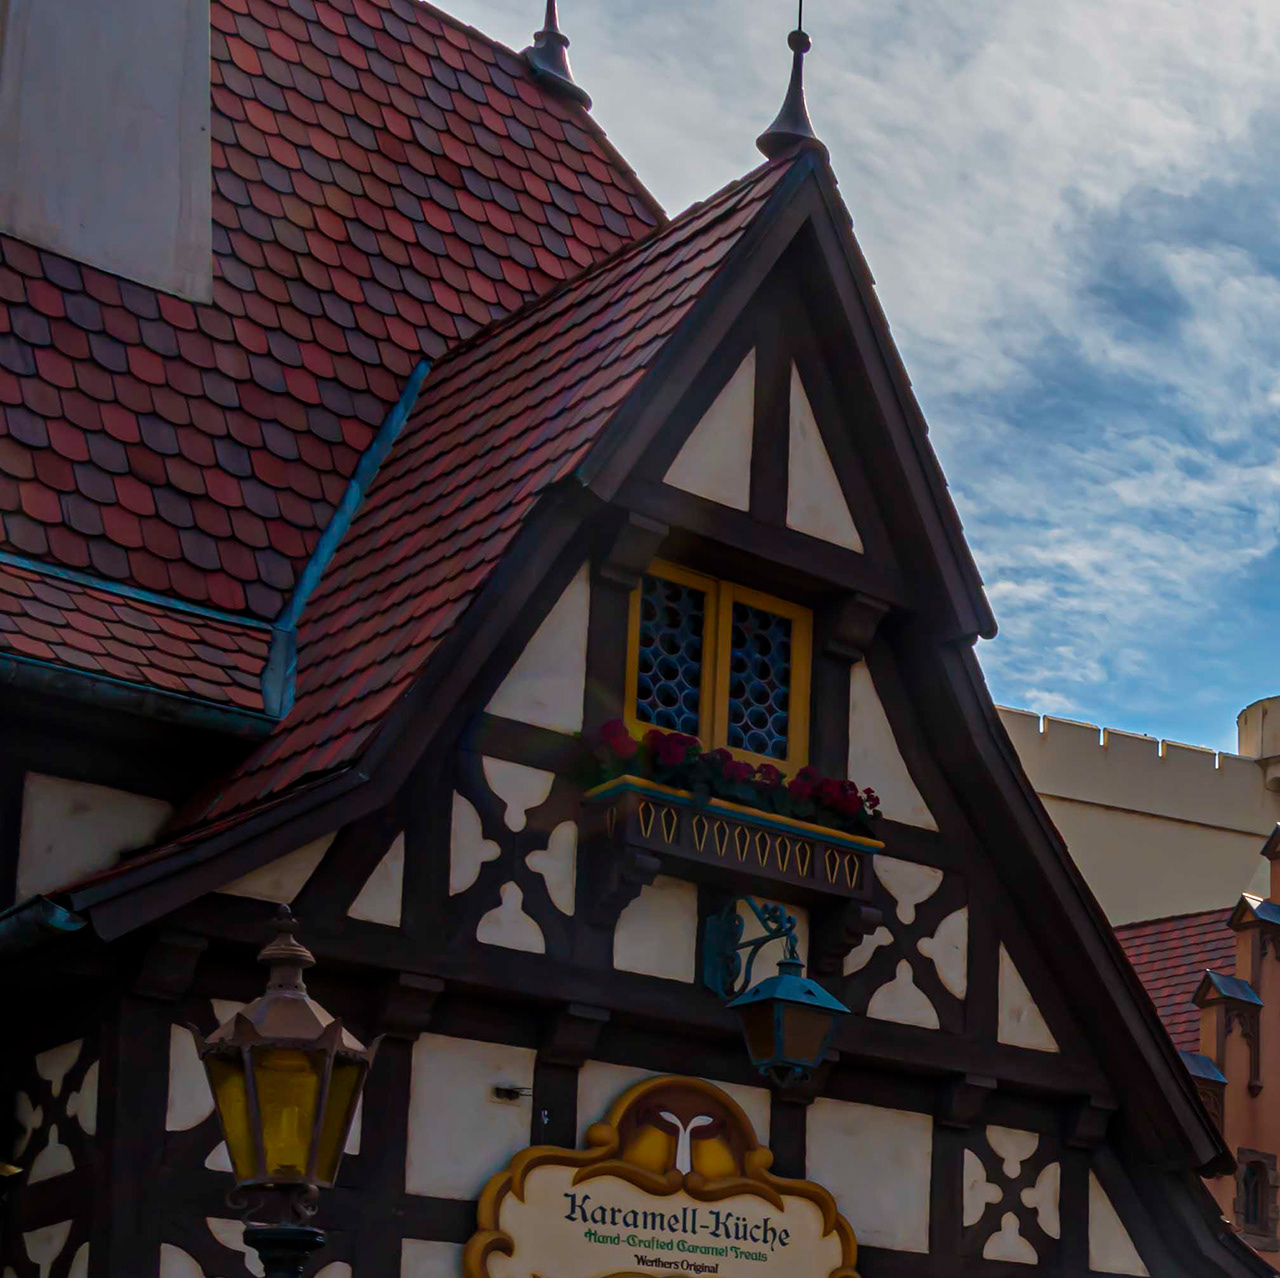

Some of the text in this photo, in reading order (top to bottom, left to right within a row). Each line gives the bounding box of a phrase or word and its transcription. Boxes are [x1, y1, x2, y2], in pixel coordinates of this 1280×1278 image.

[563, 1192, 790, 1252] Karamell-Küche
[584, 1228, 768, 1262] Hand-Crafted Caramel Treats
[680, 1259, 719, 1275] Original
